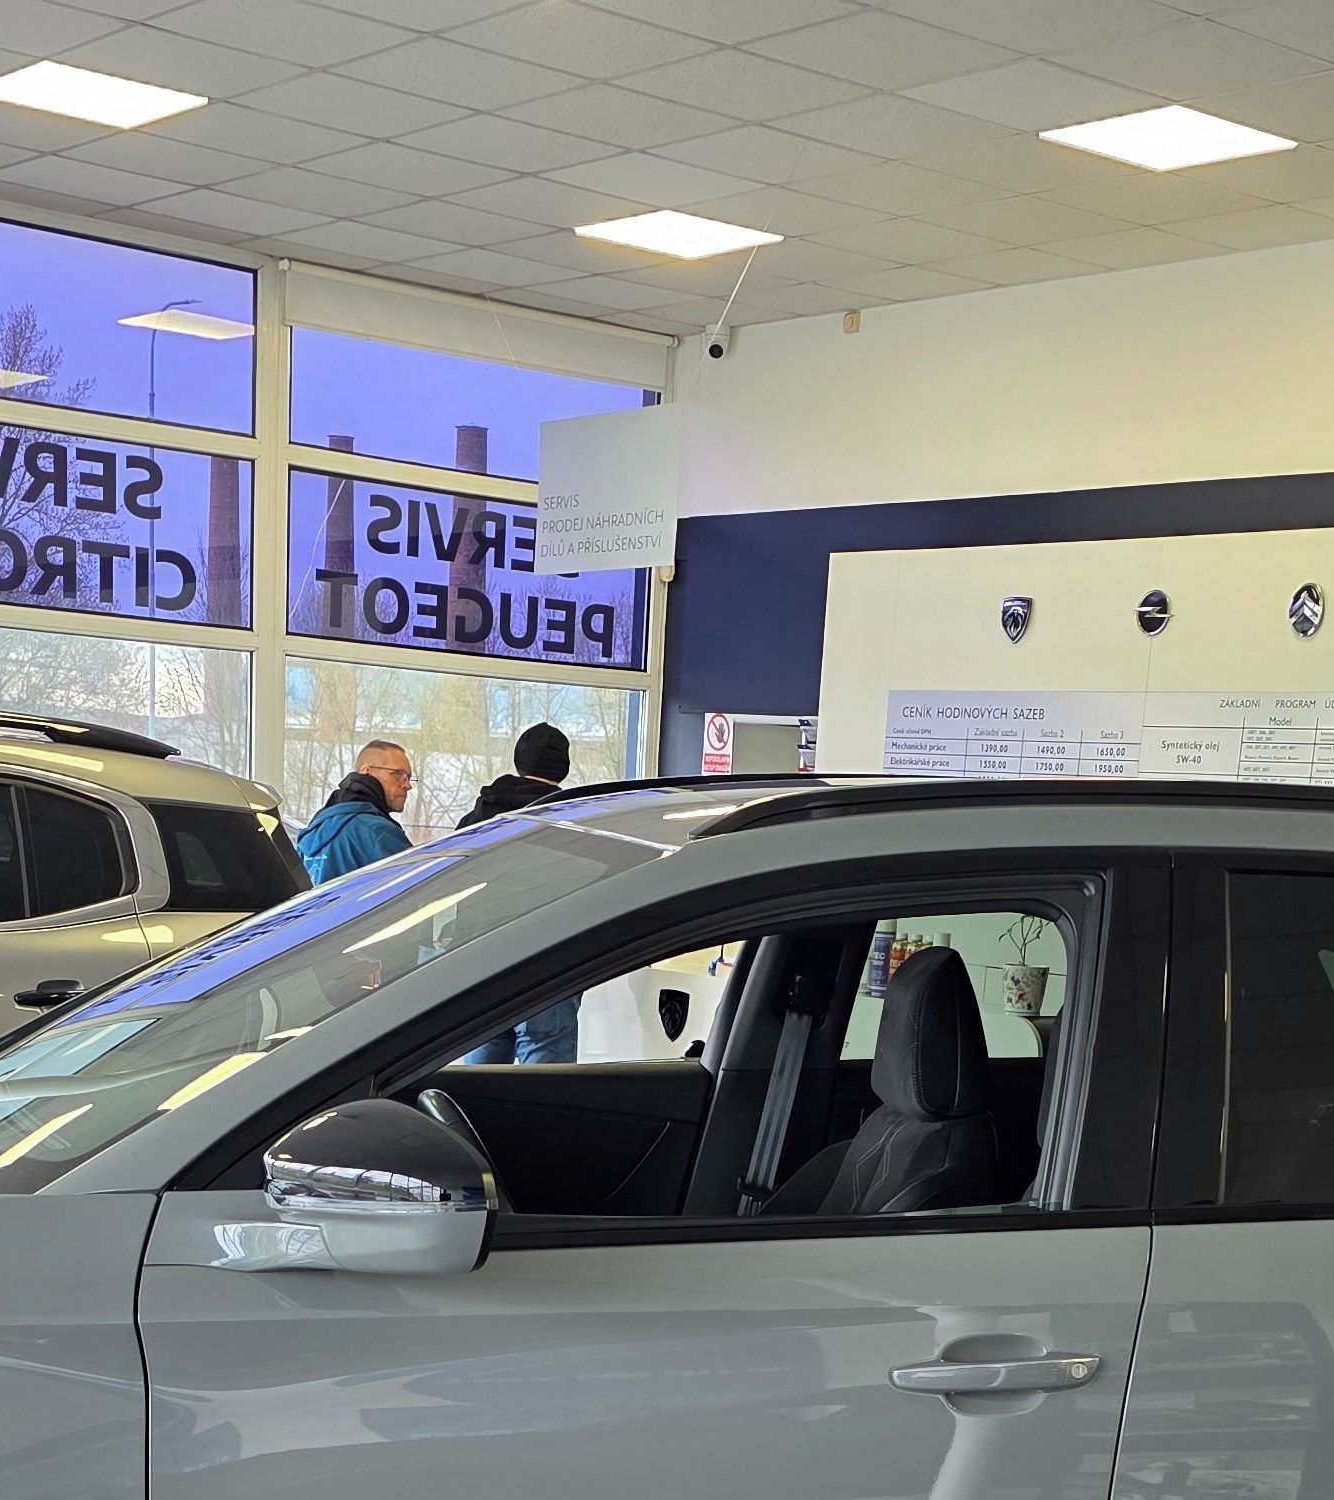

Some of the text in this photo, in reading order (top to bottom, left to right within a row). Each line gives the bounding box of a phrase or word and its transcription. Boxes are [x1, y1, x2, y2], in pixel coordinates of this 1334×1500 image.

[542, 494, 580, 511] SERVIS
[541, 507, 664, 534] PRODEJ NÁHRADNÍCH
[540, 531, 662, 558] DÍLŮ A PŘÍSLUŠENSTVÍ
[1219, 697, 1261, 708] ZÁKLADNÍ
[1275, 699, 1316, 709] PROGRAM
[902, 704, 1045, 720] CENÍK HODINOVÝCH SAZEB
[1268, 717, 1292, 726] Model
[1037, 746, 1066, 756] 1490,00
[1161, 740, 1220, 752] Syntetický olej
[1096, 748, 1126, 757] 1650,00
[1176, 755, 1202, 764] 5W-40
[1035, 762, 1064, 772] 1750,00
[1094, 764, 1124, 774] 1950,00
